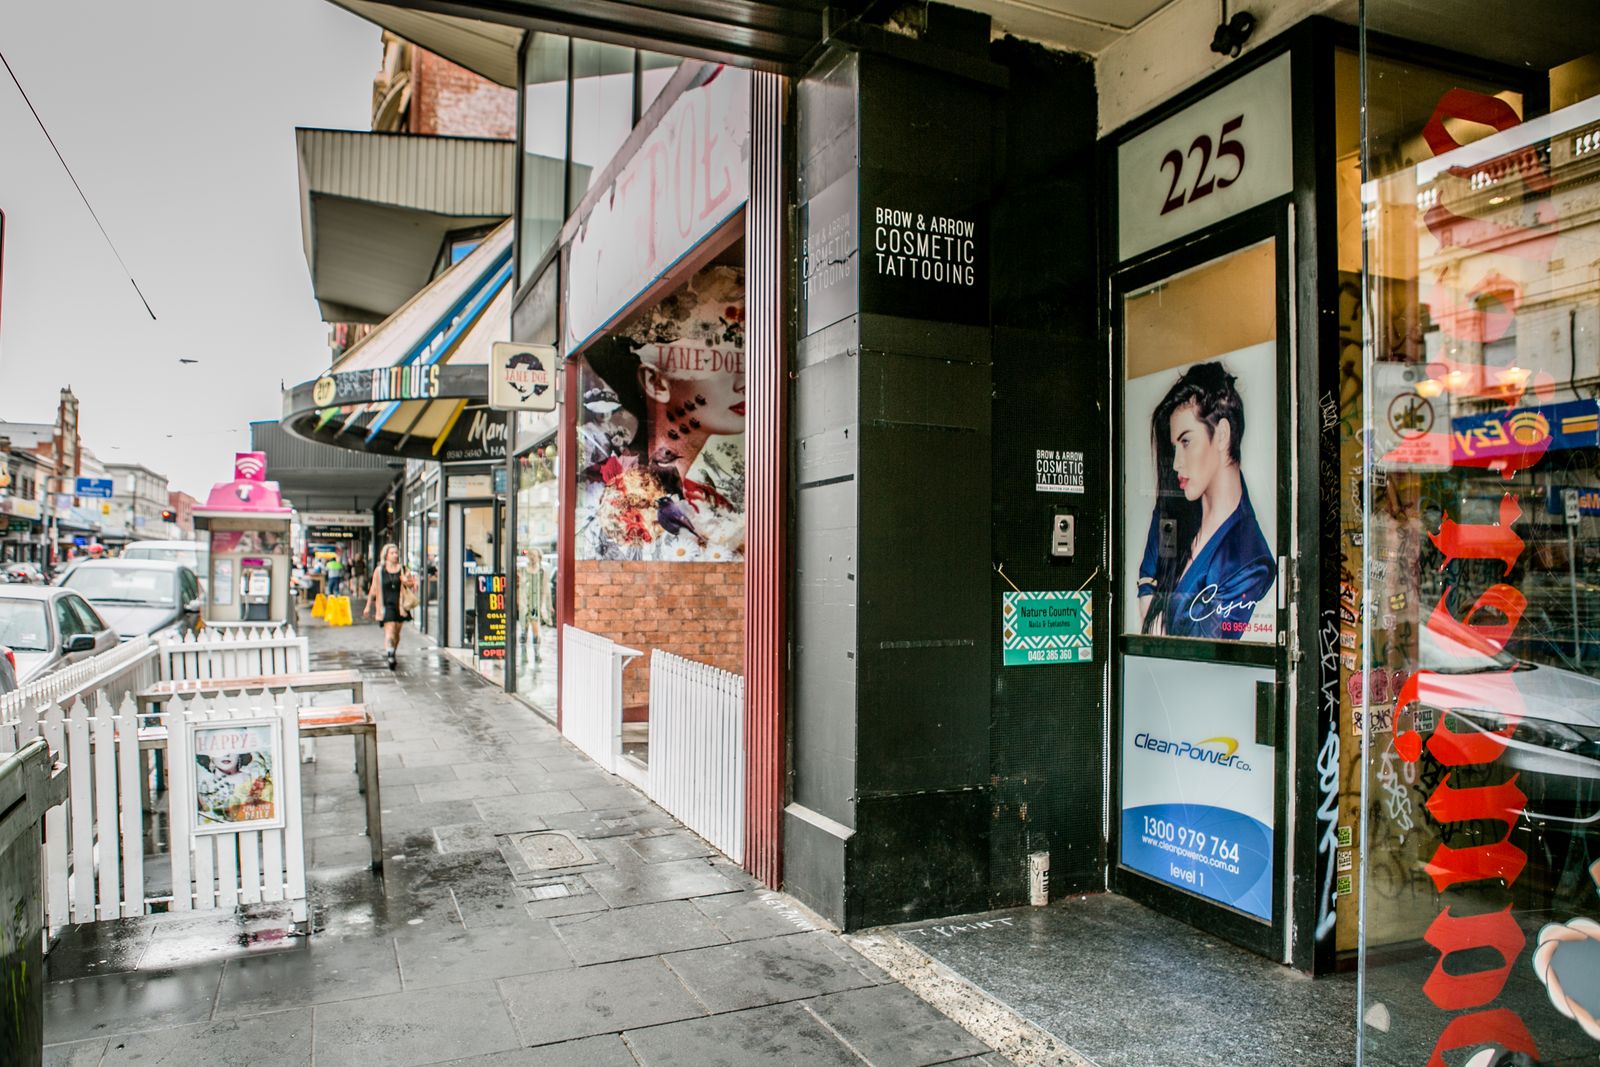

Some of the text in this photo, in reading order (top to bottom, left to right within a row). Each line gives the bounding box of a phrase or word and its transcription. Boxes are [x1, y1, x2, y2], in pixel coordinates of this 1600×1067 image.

[1160, 114, 1246, 216] 225
[876, 206, 975, 238] BROW & ARROW
[875, 226, 975, 264] COSMETIC
[875, 252, 975, 287] TATTOOING
[710, 349, 746, 375] DOE
[371, 364, 440, 401] ANTIQUES
[1036, 449, 1084, 461] BROW & ARROW
[1036, 459, 1084, 475] COSMETIC
[1036, 472, 1084, 486] TATTOOING
[1020, 605, 1078, 619] Nature Country
[1222, 621, 1232, 632] 03
[1253, 623, 1273, 633] 5444
[1027, 649, 1073, 662] 0402 385 360
[1143, 815, 1240, 863] 1300 979 764
[1141, 834, 1240, 875] www.cleanpowerco.com.au
[1170, 862, 1205, 887] level 1
